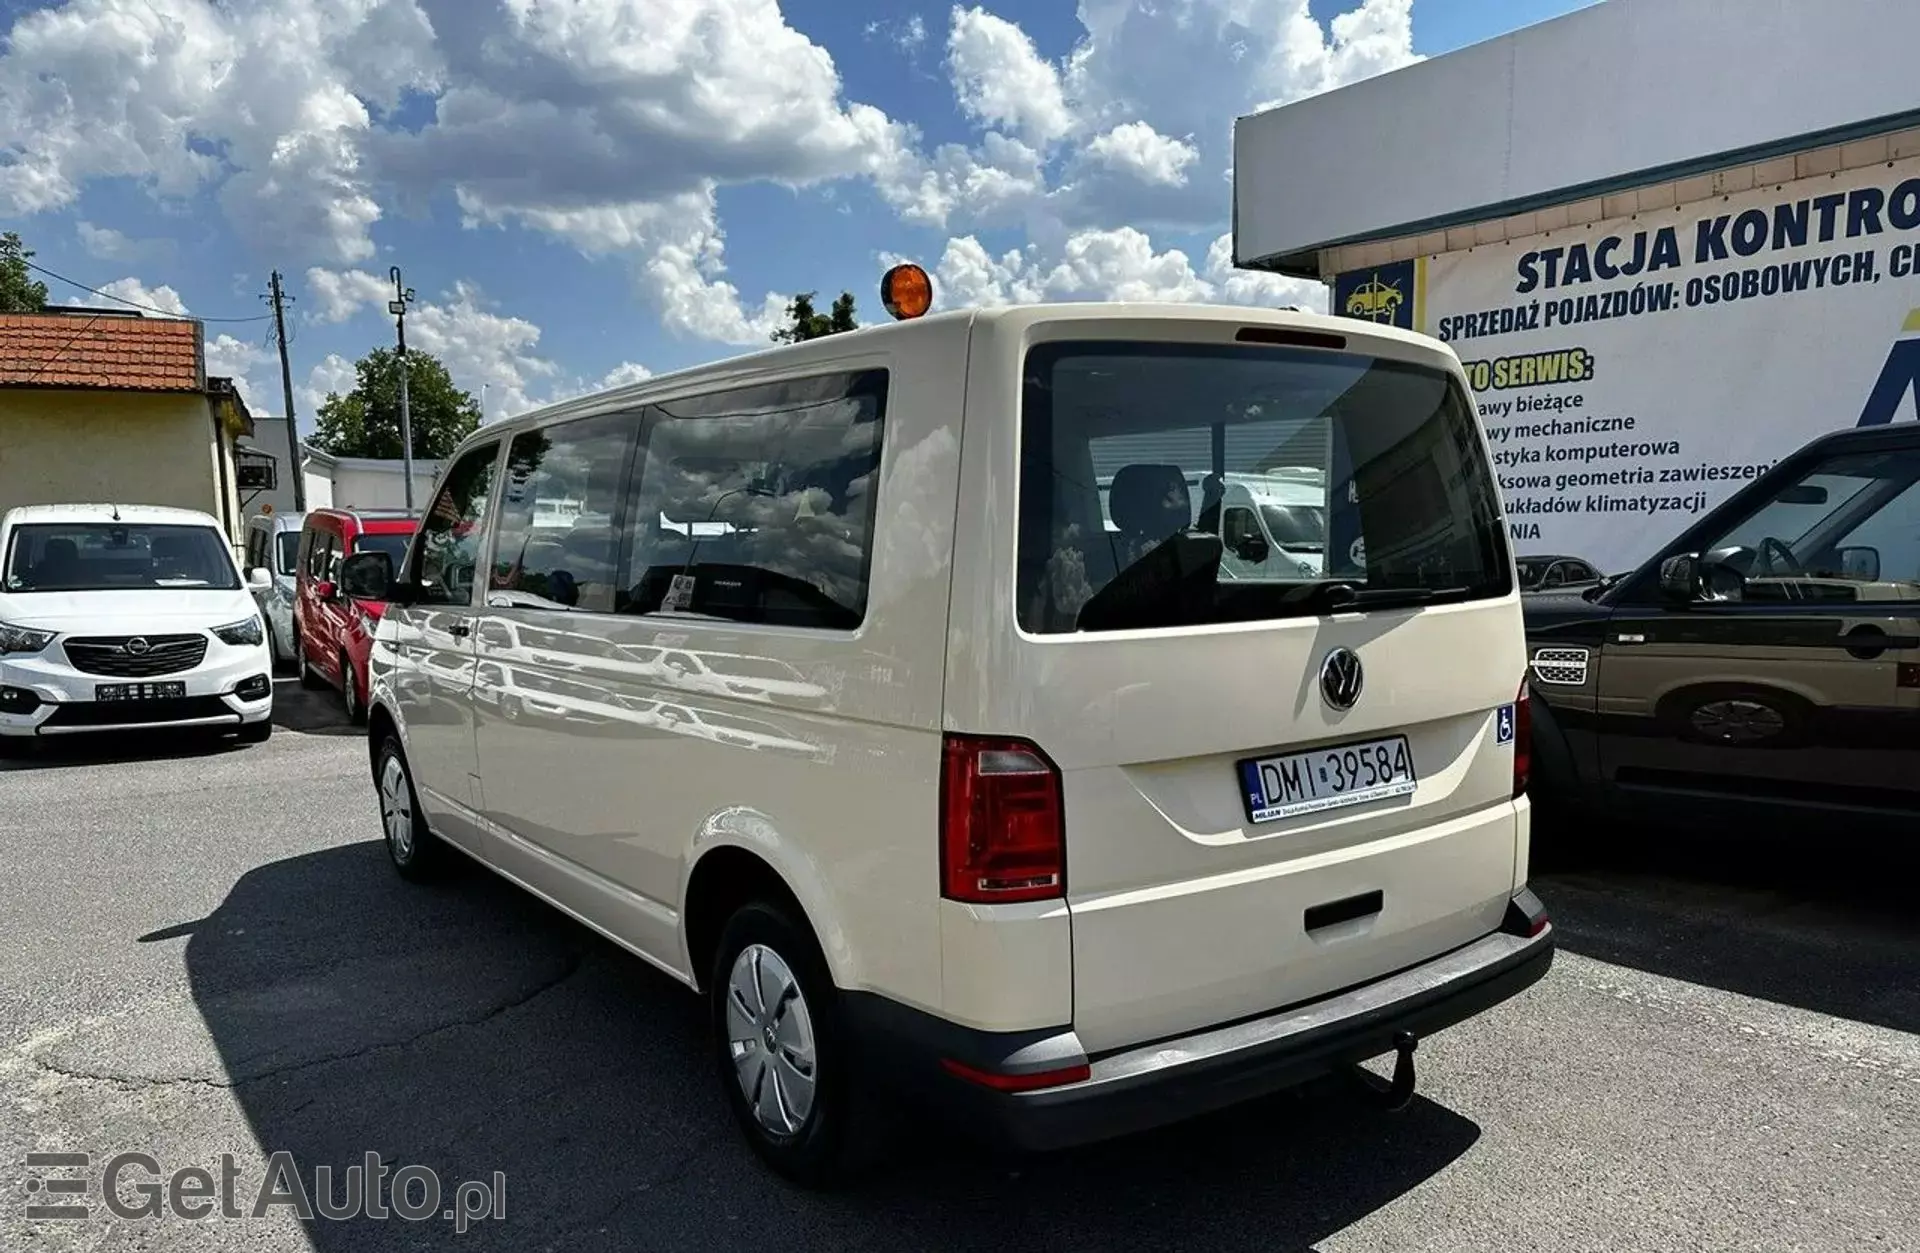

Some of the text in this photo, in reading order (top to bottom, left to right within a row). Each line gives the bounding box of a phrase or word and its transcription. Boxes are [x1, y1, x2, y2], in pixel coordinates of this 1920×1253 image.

[1516, 178, 1920, 293] STACJA KONTRO
[1439, 299, 1539, 342] SPRZEDAŻ
[1544, 282, 1679, 328] POJAZDÓW:
[1685, 251, 1880, 307] OSOBOWYCH,
[1493, 347, 1595, 390] SERWIS:
[1516, 394, 1584, 414] bieżące
[1515, 416, 1635, 438] mechaniczne
[1493, 440, 1680, 467] styka komputerowa
[1555, 466, 1654, 491] geometria
[1504, 491, 1707, 515] układów klimatyzacji
[1260, 756, 1316, 804] DMI
[1326, 743, 1409, 793] 39584
[1250, 793, 1262, 805] PL
